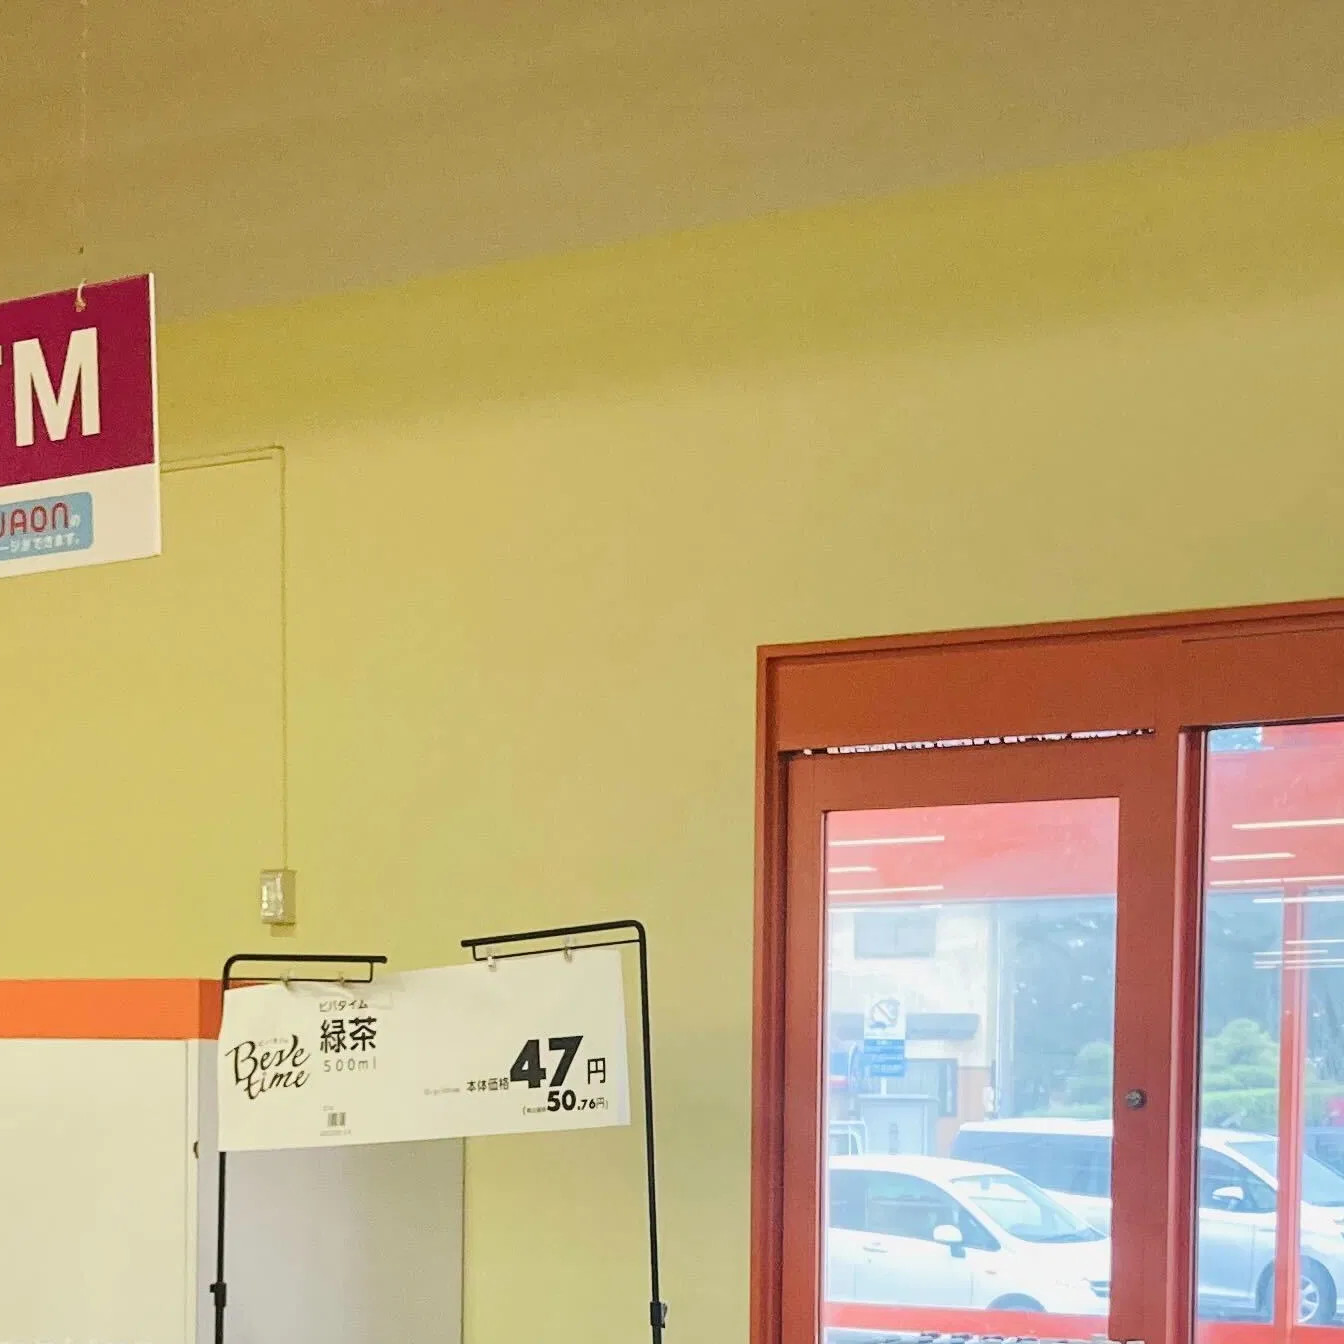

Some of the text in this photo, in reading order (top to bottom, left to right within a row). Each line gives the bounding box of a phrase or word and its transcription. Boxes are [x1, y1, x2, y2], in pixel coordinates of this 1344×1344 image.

[320, 1016, 377, 1053] 緑茶
[323, 1056, 377, 1072] 500ml
[466, 1036, 606, 1092] 本体価格 47 円
[245, 1069, 310, 1099] time
